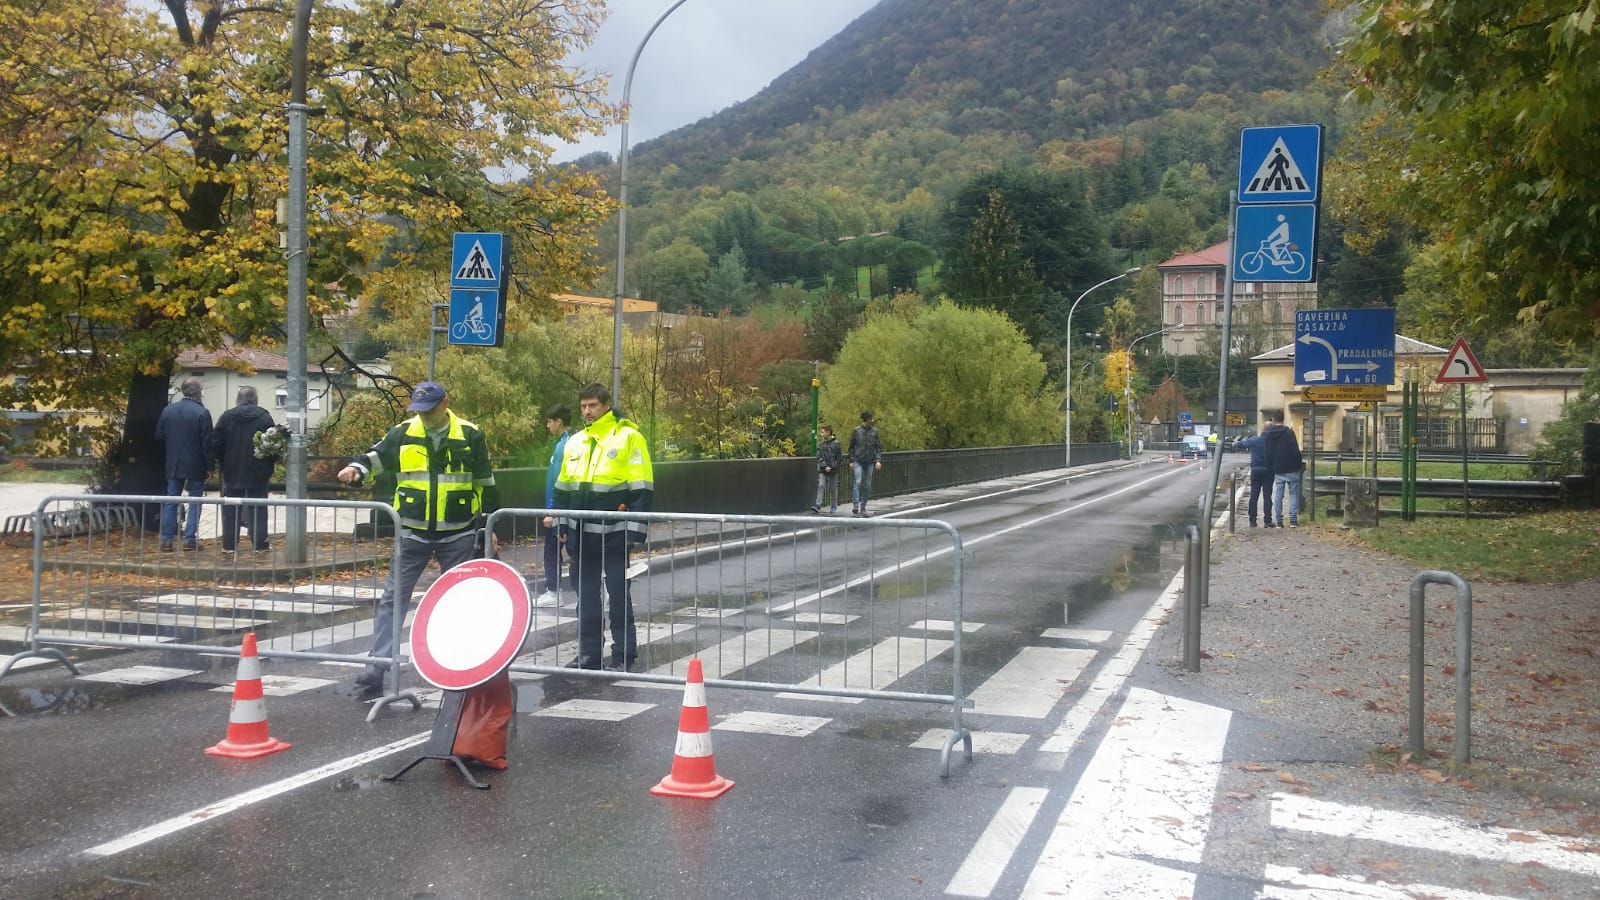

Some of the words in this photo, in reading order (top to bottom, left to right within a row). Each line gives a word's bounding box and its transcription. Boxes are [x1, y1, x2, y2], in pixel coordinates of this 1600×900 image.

[1297, 312, 1348, 321] GAVERINA
[1297, 322, 1345, 331] CASAZZA
[1338, 349, 1394, 358] PRADALUNGA
[1344, 374, 1350, 384] A
